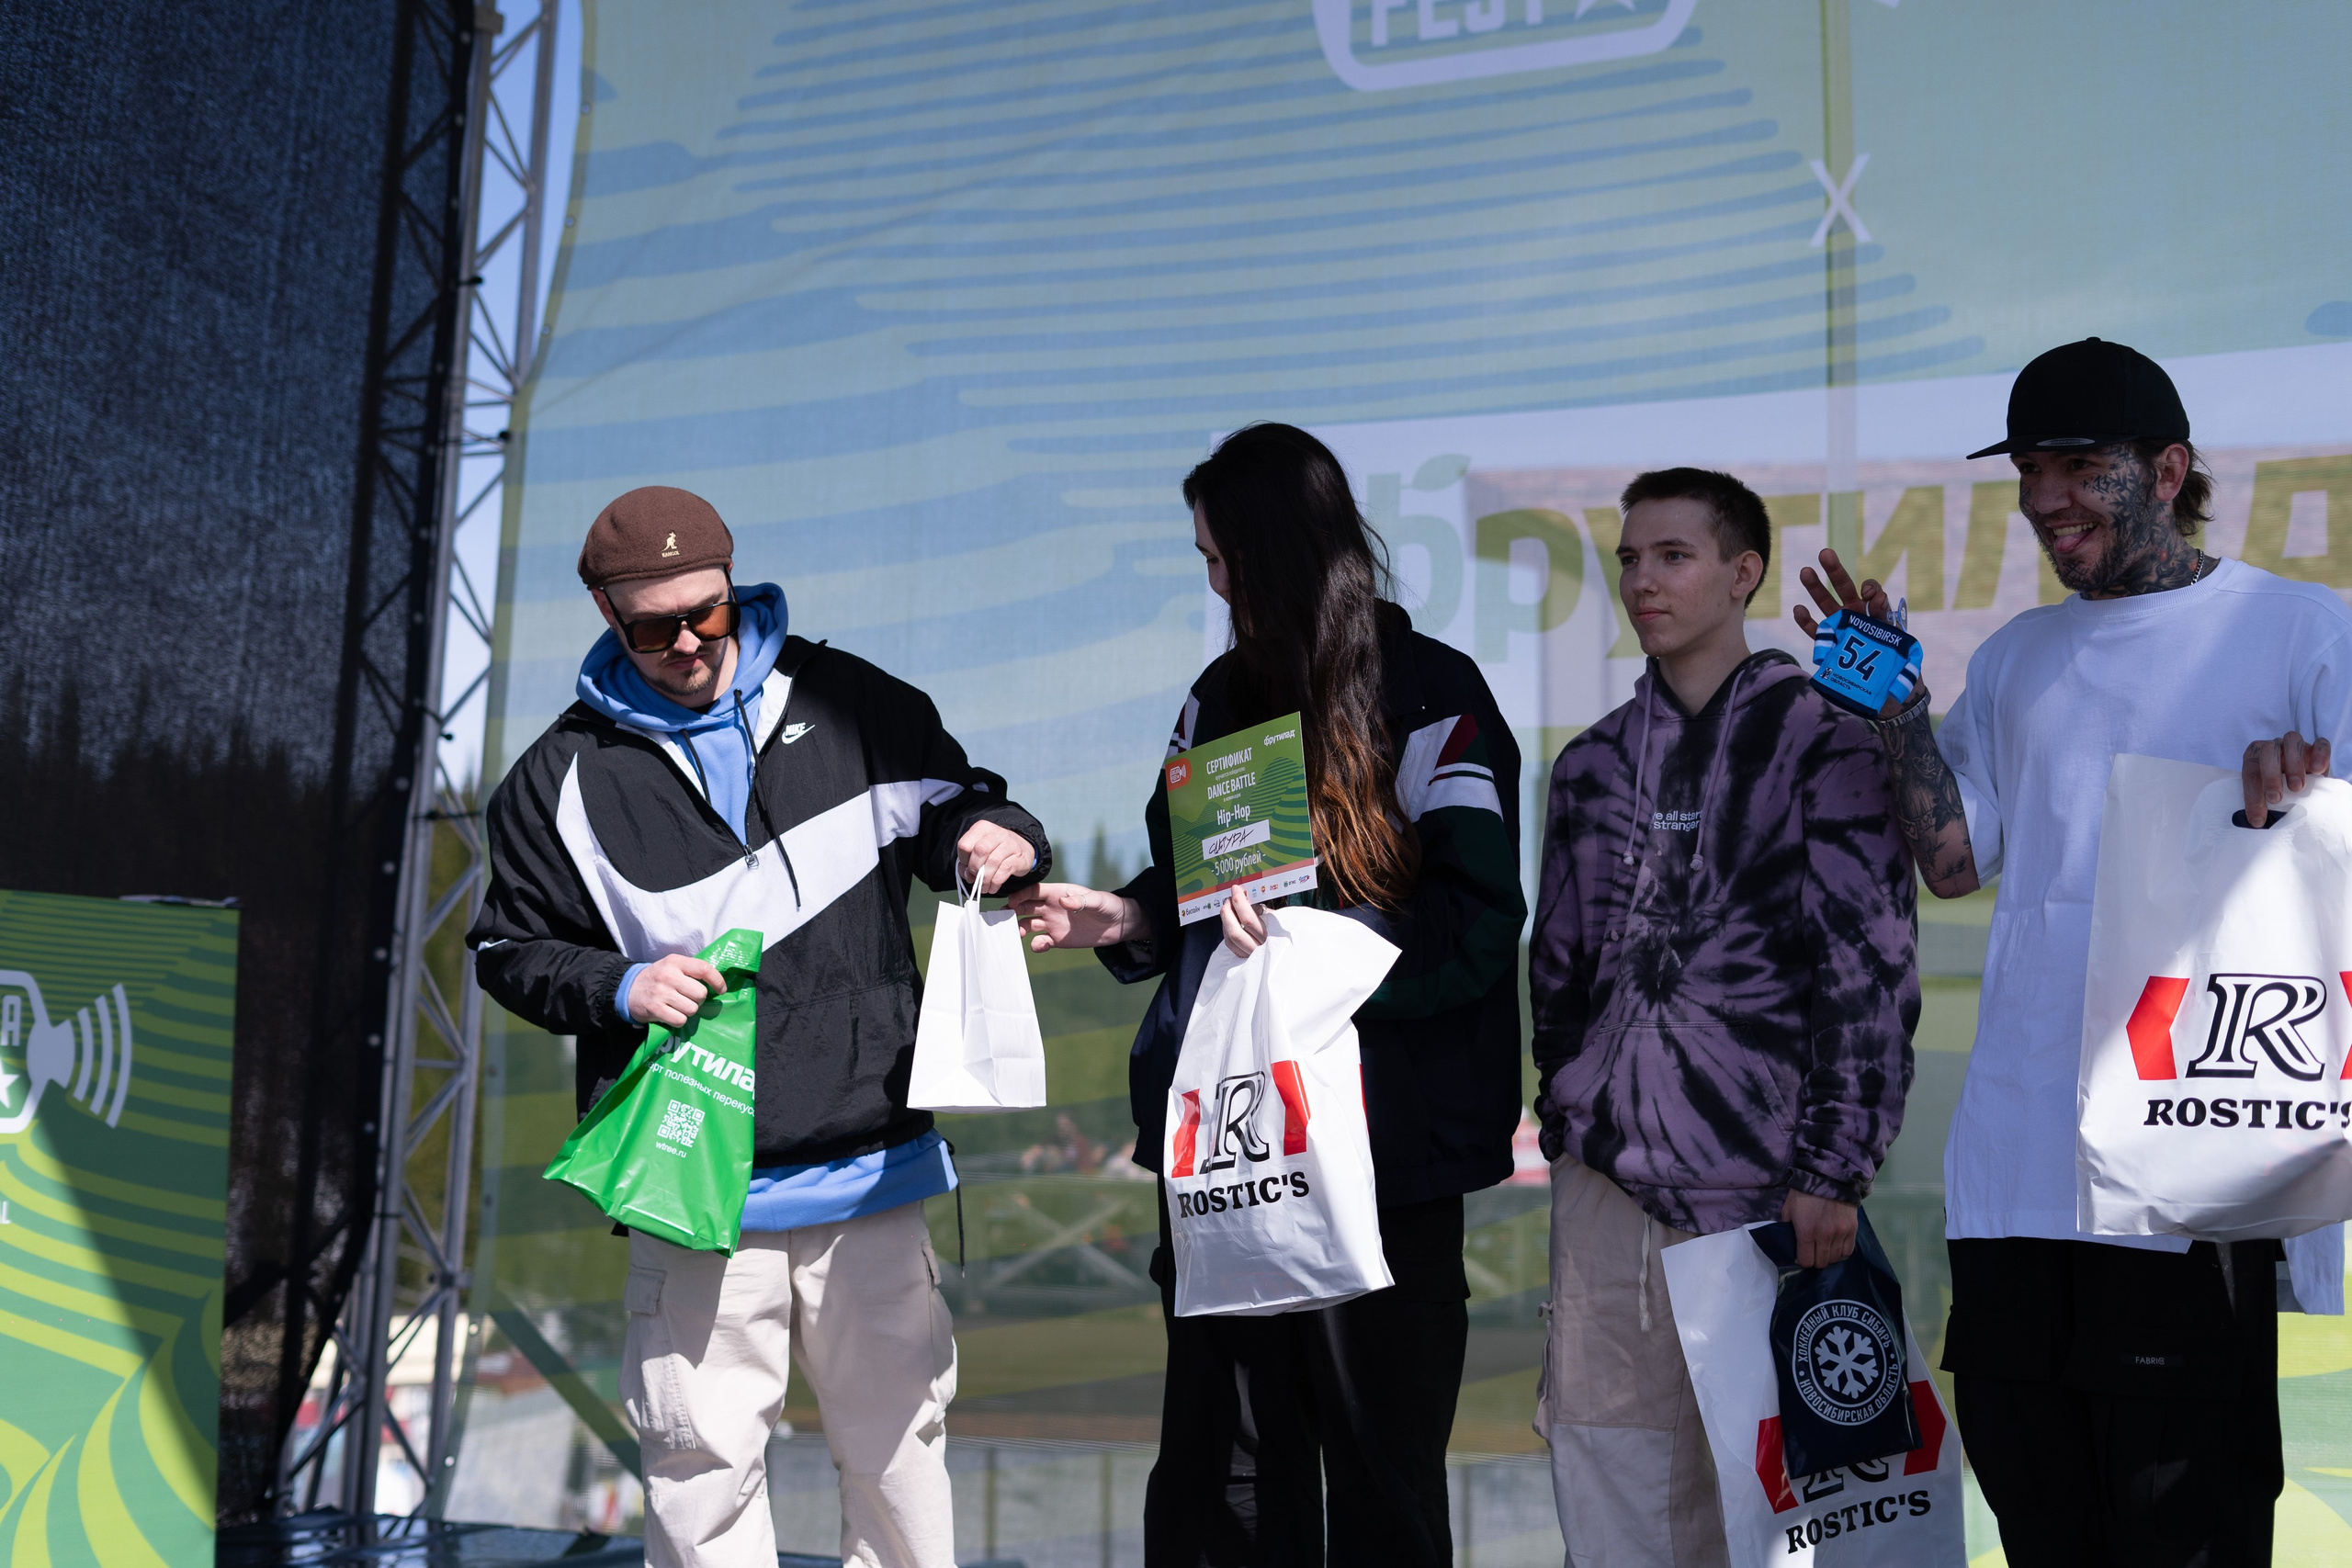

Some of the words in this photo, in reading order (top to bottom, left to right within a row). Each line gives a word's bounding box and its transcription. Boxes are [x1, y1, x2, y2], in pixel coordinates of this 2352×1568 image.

[1849, 615, 1903, 647] NOVOSIBIRSK
[1838, 634, 1883, 682] 54
[1206, 747, 1252, 774] СЕРТИФИКАТ
[1207, 779, 1230, 799] DANCE
[1231, 772, 1256, 792] BATTLE
[1216, 804, 1250, 828] Hip-Hop
[1654, 819, 1700, 831] stranger
[1666, 810, 1679, 821] all
[1235, 851, 1261, 874] рублей
[664, 1067, 712, 1096] полезных
[655, 1141, 687, 1158] wtree.ru
[1178, 1171, 1310, 1218] ROSTIC'S
[1798, 1306, 1830, 1362] ХОККЕЙНЫЙ
[1831, 1304, 1860, 1318] КЛУБ
[1861, 1311, 1893, 1348] СИБИРЬ
[1800, 1379, 1875, 1422] НОВОСИБИРСКАЯ
[1874, 1363, 1899, 1409] ОБЛАСТЬ
[1786, 1490, 1931, 1554] ROSTIC'S
